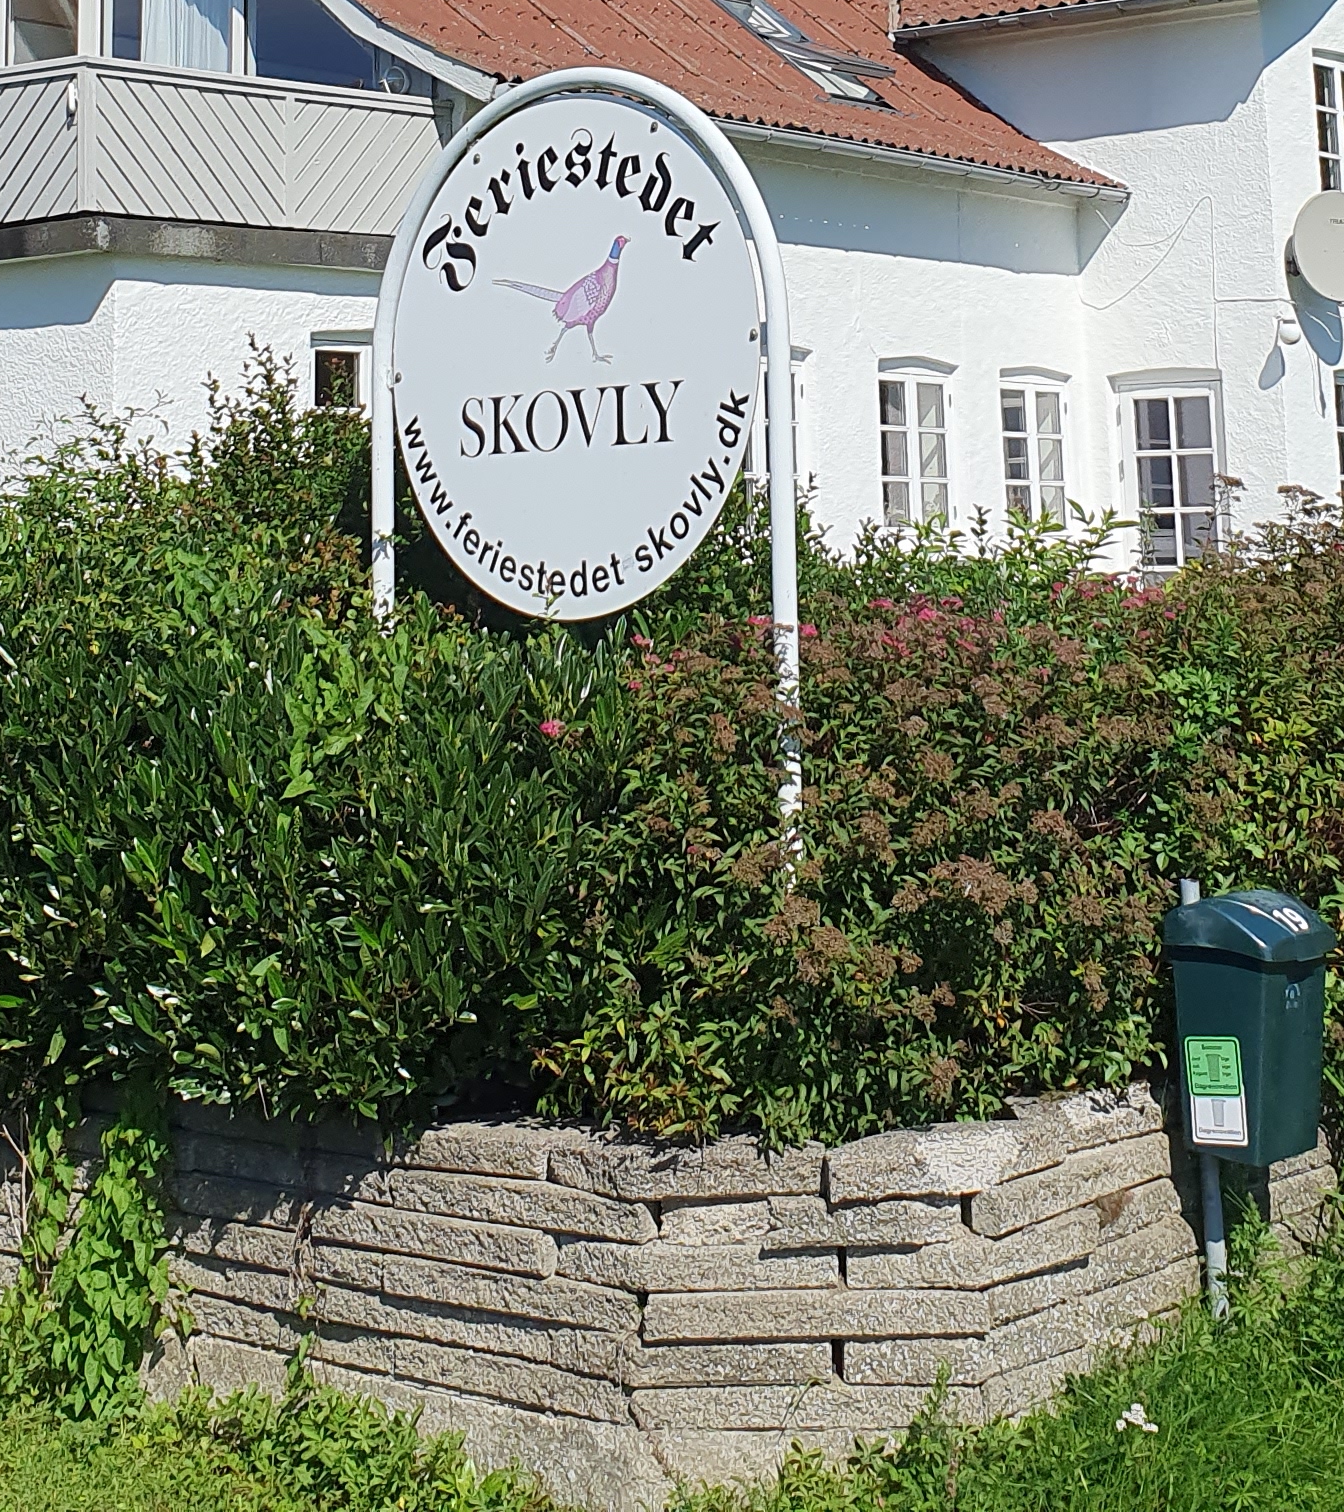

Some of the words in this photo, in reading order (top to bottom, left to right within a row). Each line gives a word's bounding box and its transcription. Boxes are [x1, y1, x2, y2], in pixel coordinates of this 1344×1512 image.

[423, 128, 721, 292] Feriestedet
[460, 379, 685, 459] SKOVLY
[1272, 907, 1309, 932] 19
